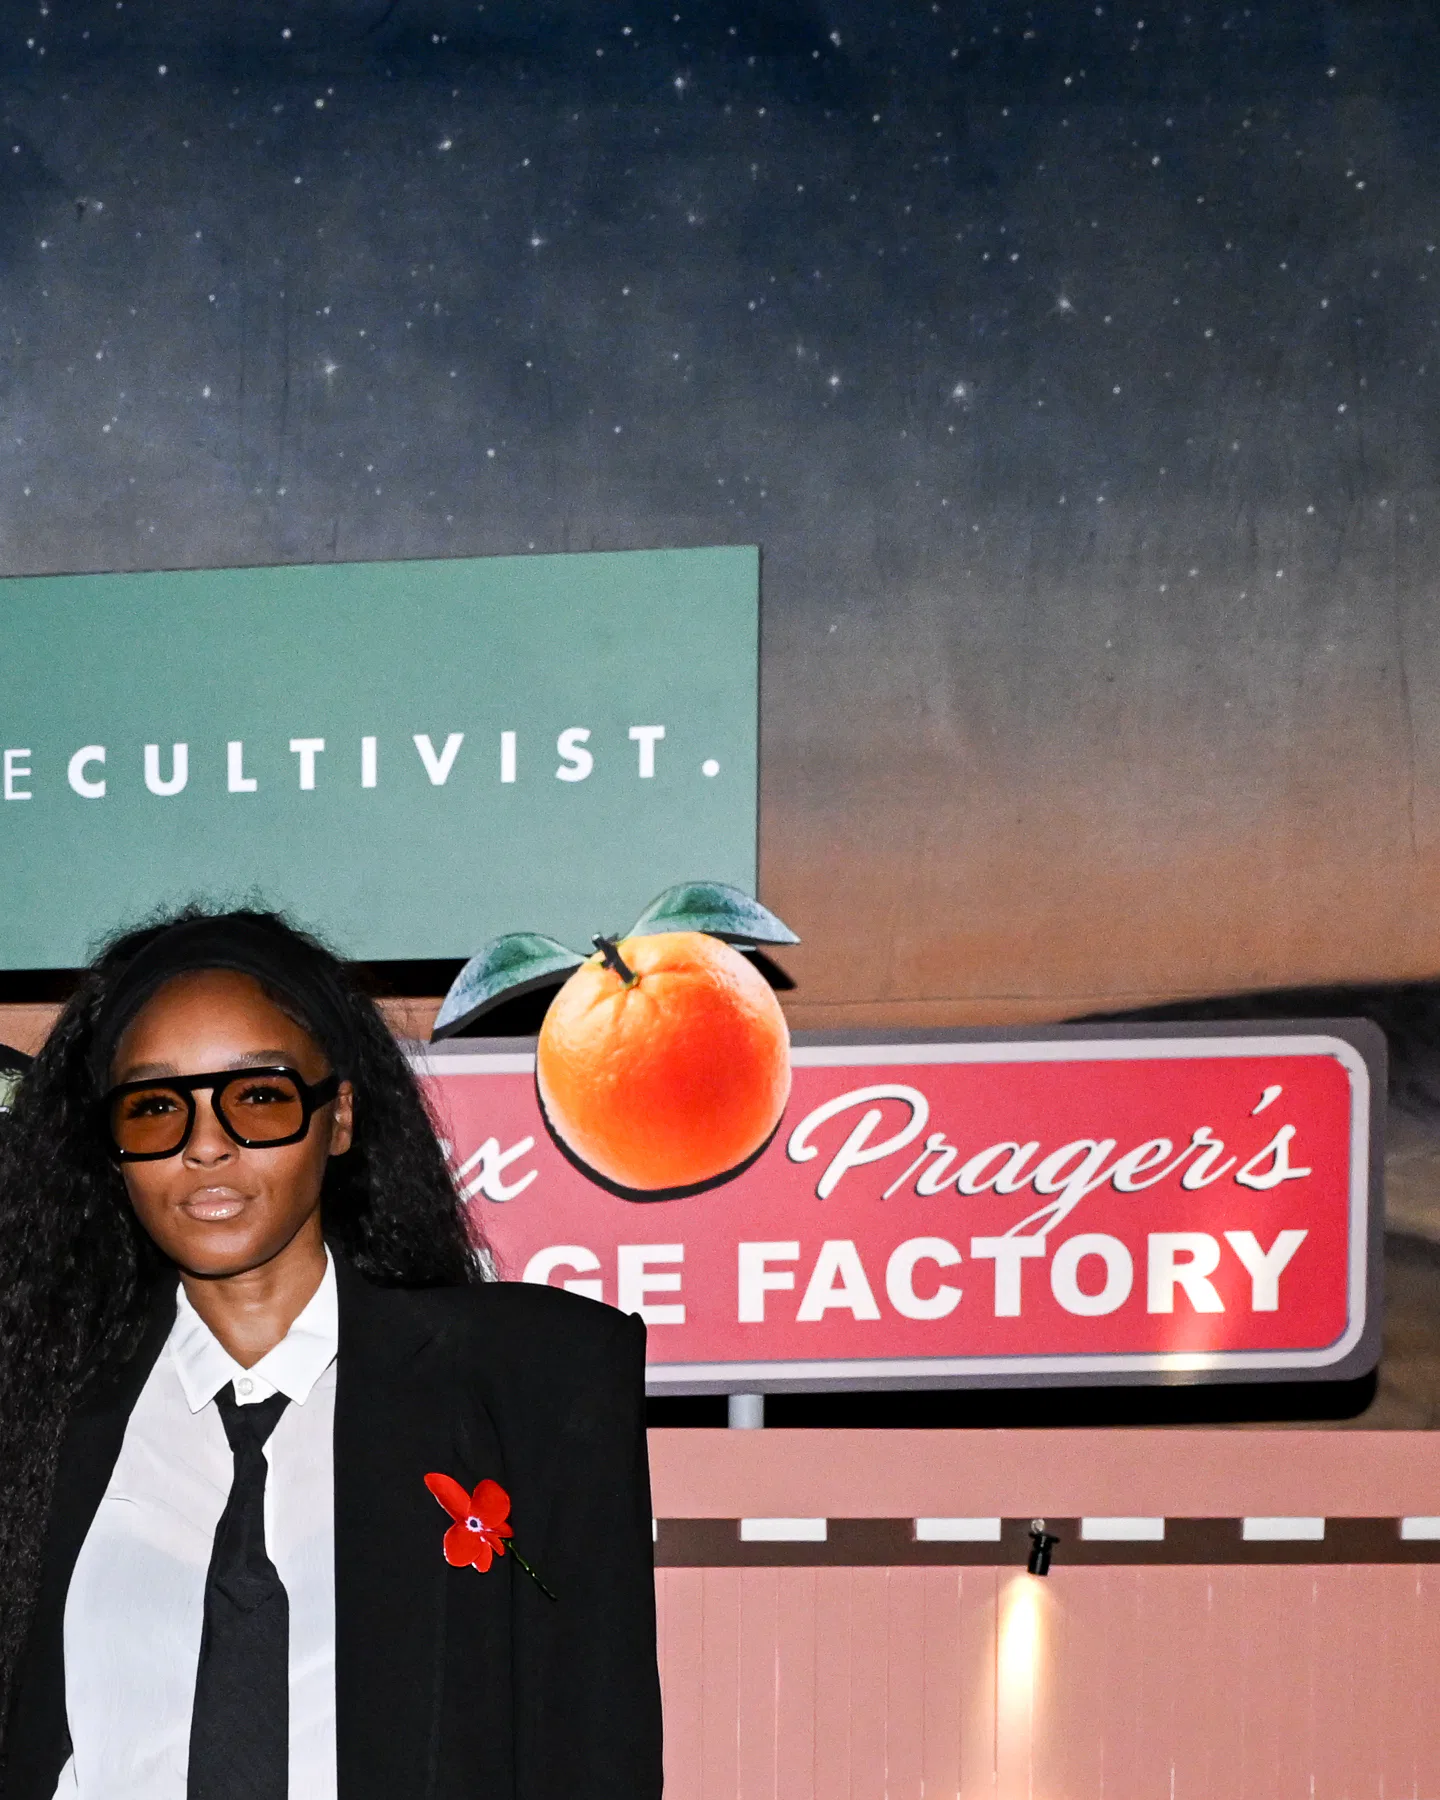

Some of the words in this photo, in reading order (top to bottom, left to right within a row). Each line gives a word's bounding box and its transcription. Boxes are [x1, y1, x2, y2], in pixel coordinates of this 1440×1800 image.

[67, 724, 722, 799] CULTIVIST.
[787, 1083, 1311, 1240] Prager's
[478, 1243, 687, 1325] GE
[736, 1229, 1309, 1323] FACTORY
